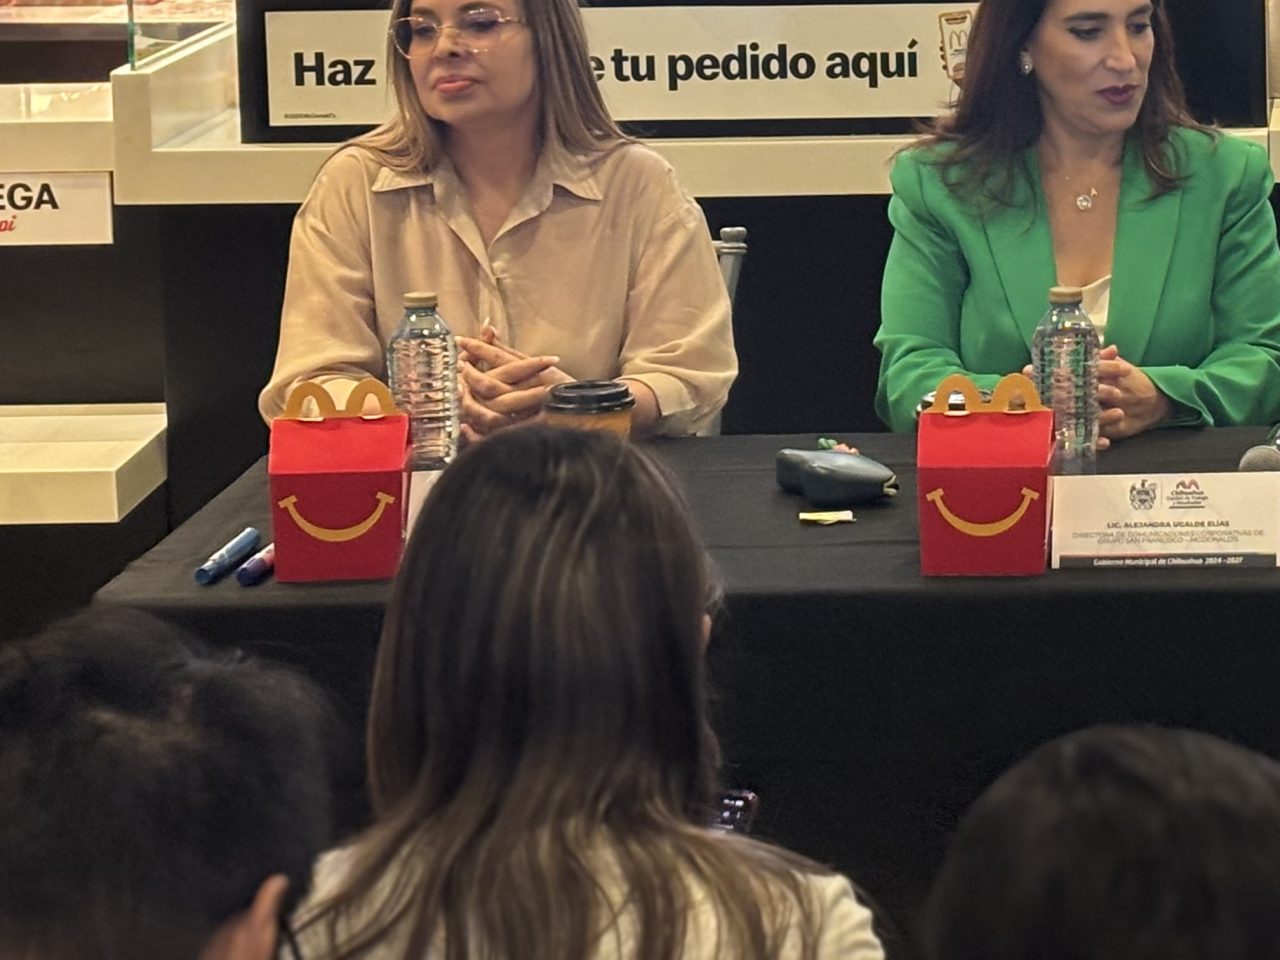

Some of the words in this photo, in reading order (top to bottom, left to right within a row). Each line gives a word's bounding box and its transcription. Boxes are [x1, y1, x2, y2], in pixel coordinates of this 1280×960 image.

[294, 51, 377, 87] Haz
[610, 48, 656, 82] tu
[667, 41, 816, 92] pedido
[825, 40, 919, 87] aquí
[1107, 521, 1122, 529] LIC.
[1124, 520, 1171, 529] ALEJANDRA
[1173, 520, 1206, 528] UGALDE
[1207, 519, 1230, 528] ELÍAS
[1254, 529, 1264, 537] DE
[1093, 558, 1124, 567] Gobierno
[1125, 558, 1157, 567] Municipal
[1158, 558, 1167, 566] de
[1168, 557, 1203, 566] Chihuahua
